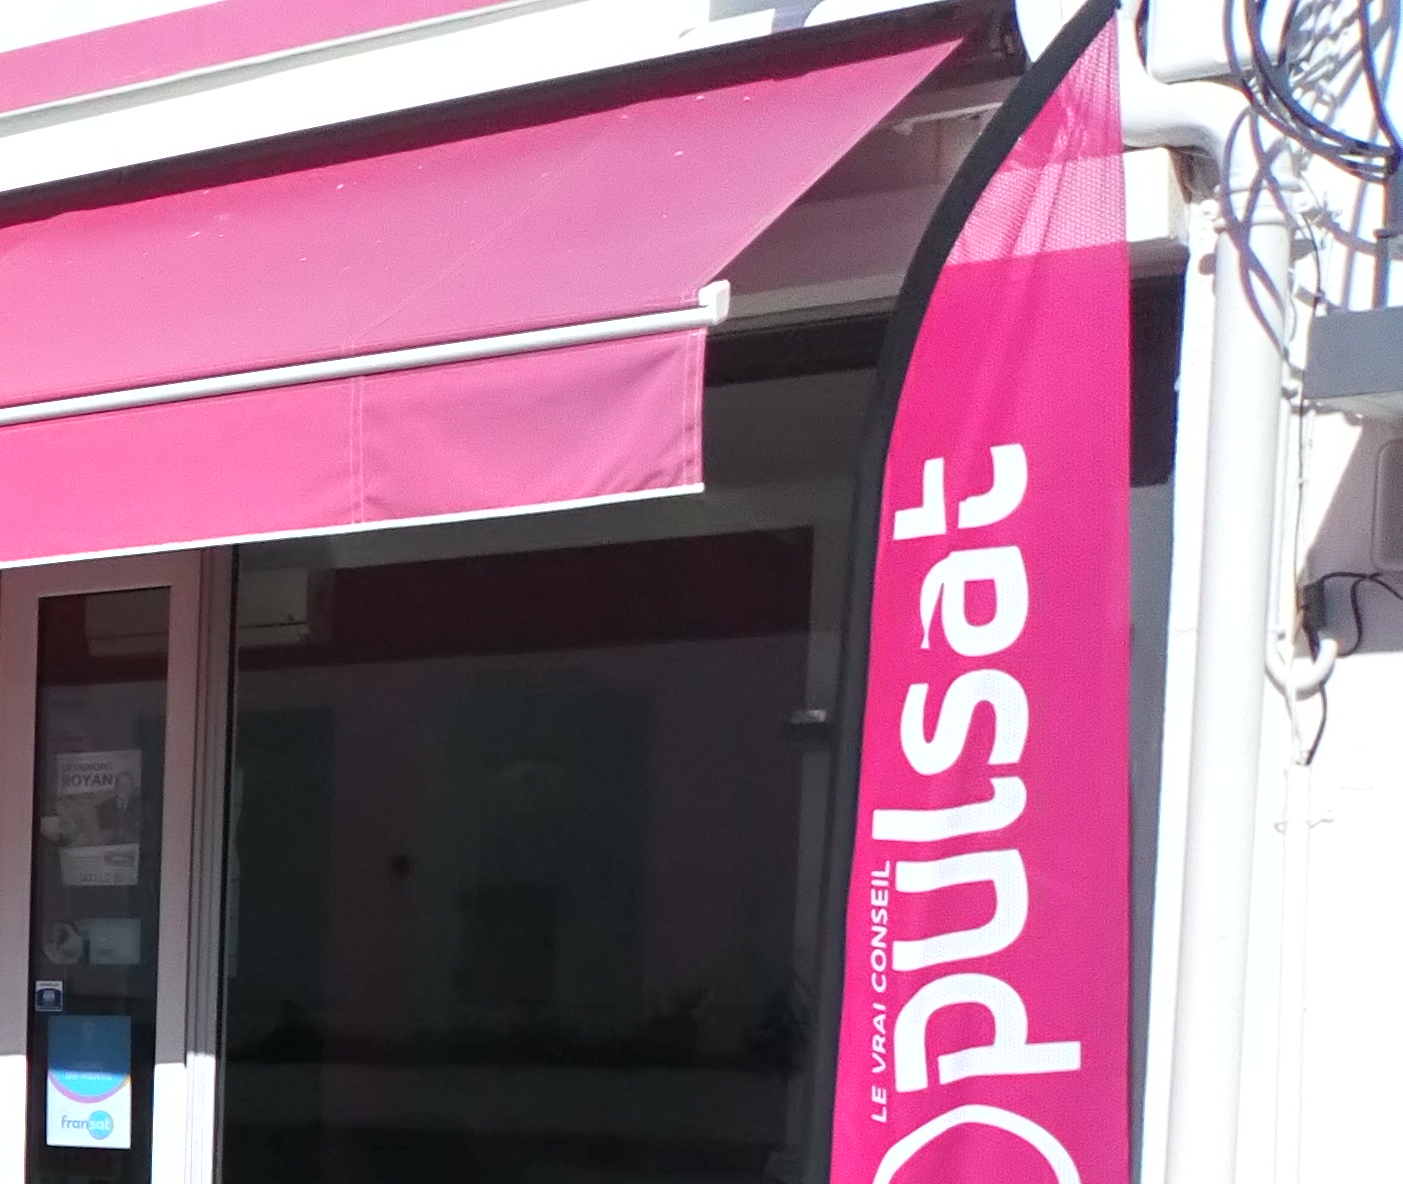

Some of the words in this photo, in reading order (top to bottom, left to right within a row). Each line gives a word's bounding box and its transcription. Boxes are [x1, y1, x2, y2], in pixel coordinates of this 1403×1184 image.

[872, 443, 1083, 1094] pulsat
[870, 860, 891, 993] CONSEIL
[871, 1002, 887, 1074] VRAI
[61, 1114, 111, 1131] fransat
[870, 1085, 887, 1123] LE
